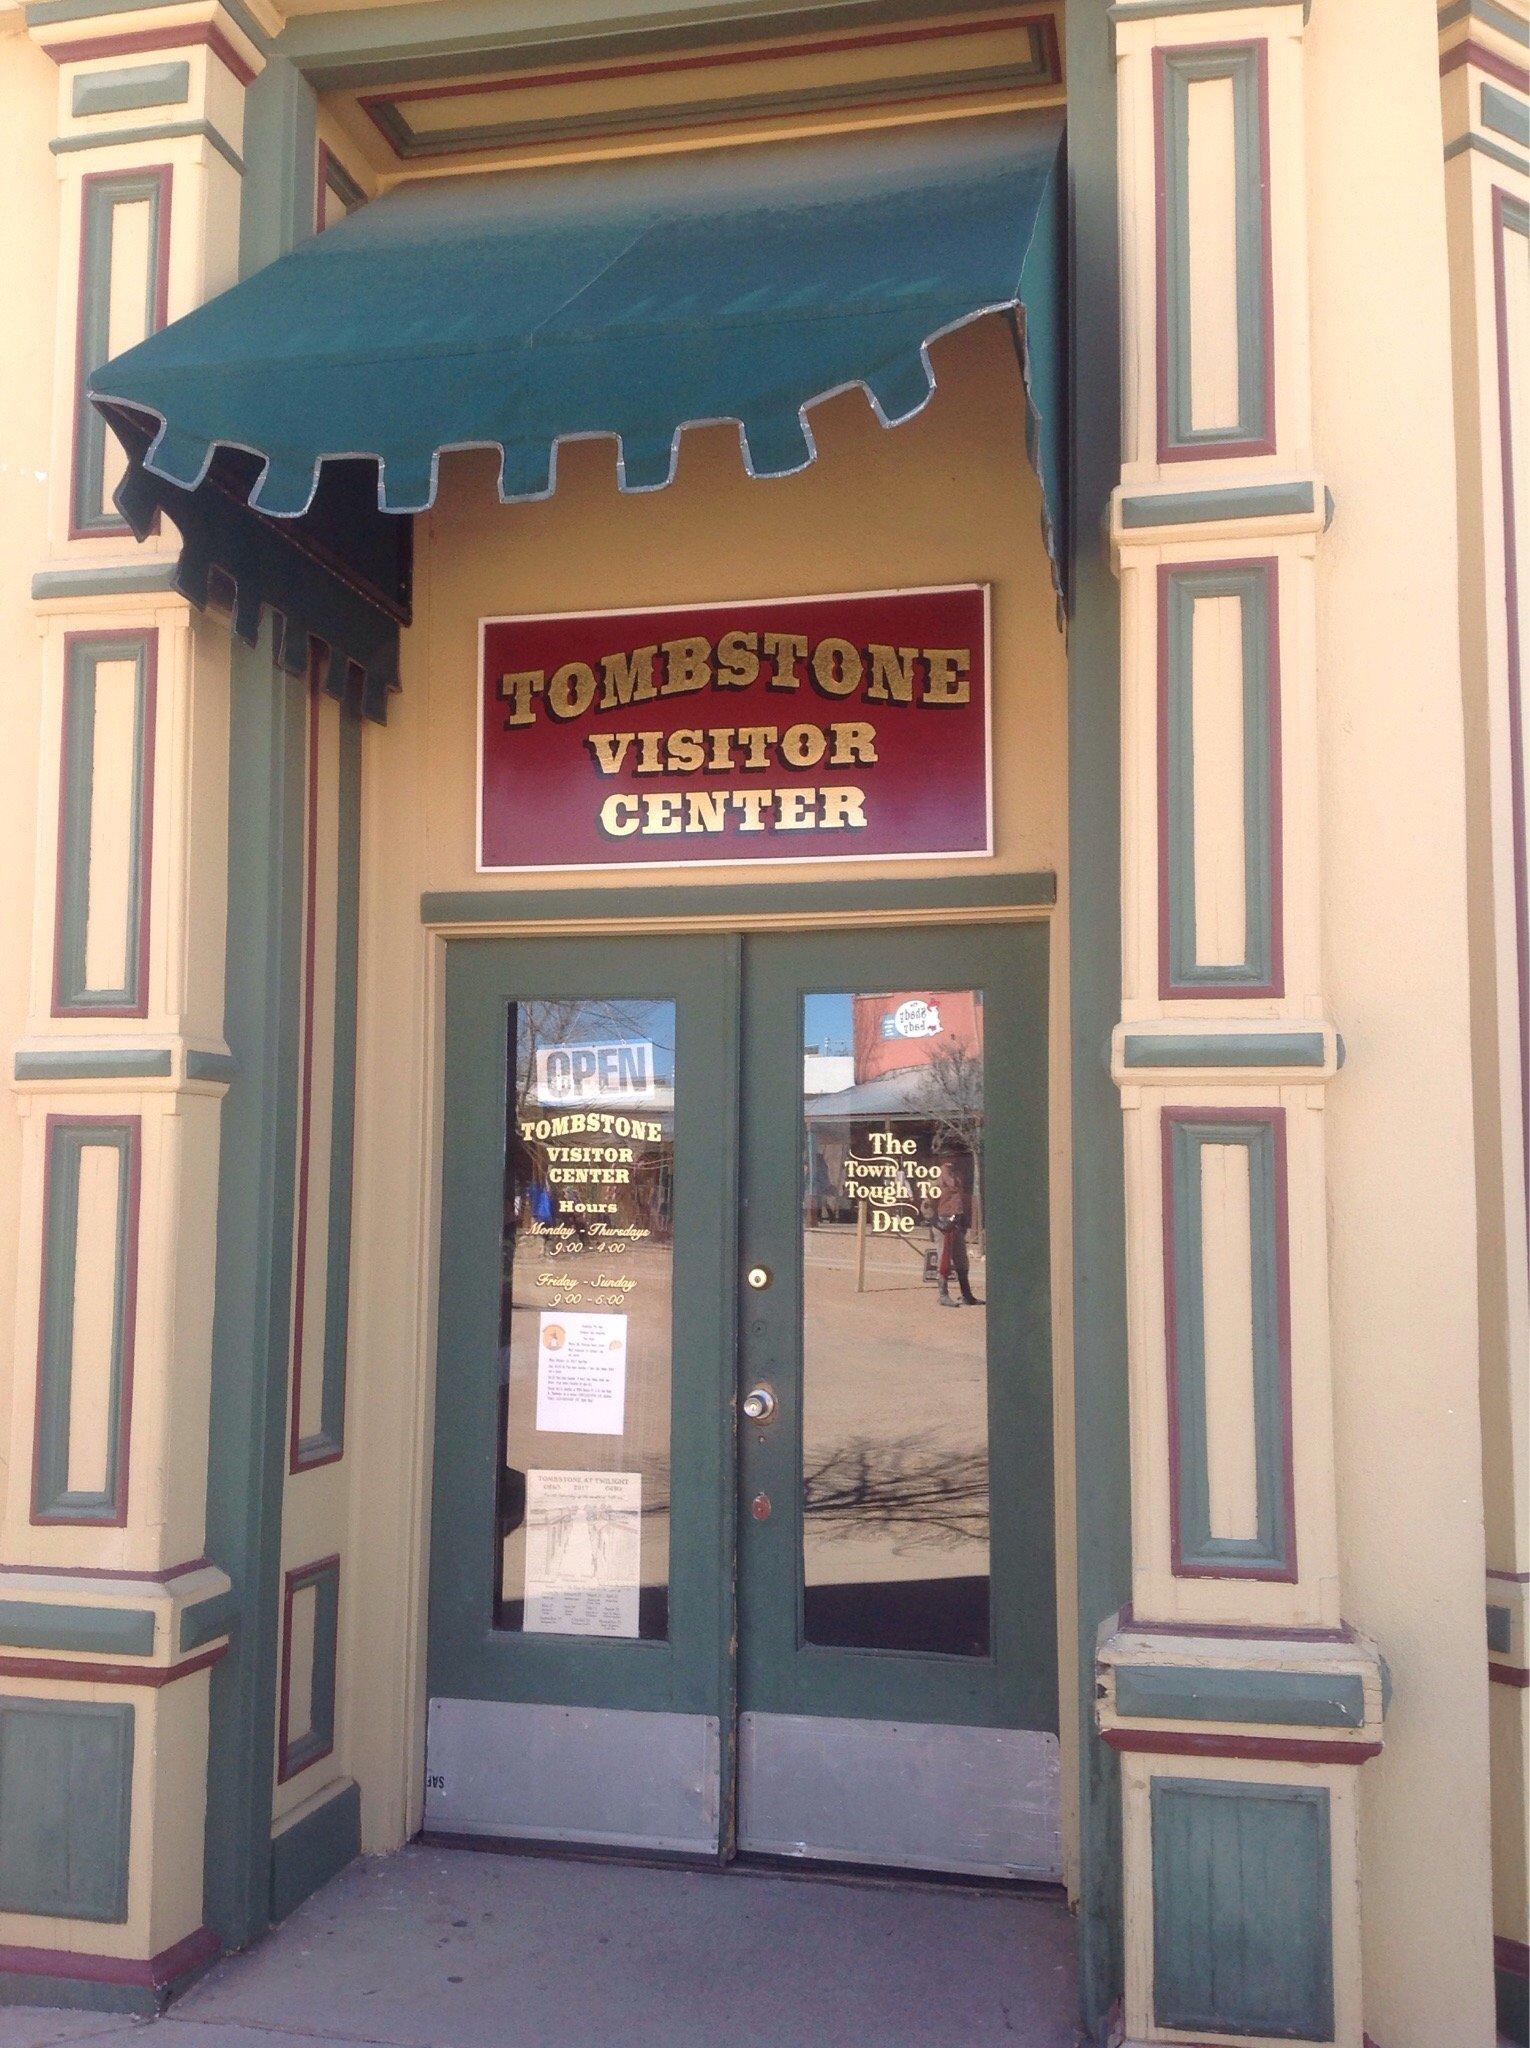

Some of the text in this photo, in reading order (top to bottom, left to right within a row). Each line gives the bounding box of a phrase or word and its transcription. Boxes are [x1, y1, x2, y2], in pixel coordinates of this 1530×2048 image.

[501, 630, 971, 728] TOMBSTONE
[586, 721, 878, 775] VISITOR
[598, 786, 868, 837] CENTER
[546, 1046, 647, 1097] OPEN
[521, 1112, 662, 1142] TOMBSTONE
[546, 1147, 634, 1163] VISITOR
[868, 1133, 917, 1156] The
[549, 1168, 630, 1184] CENTER
[844, 1160, 942, 1179] Town Too
[845, 1181, 942, 1205] Tough To
[558, 1200, 618, 1214] Hours
[525, 1222, 576, 1240] Monday
[587, 1223, 651, 1241] Thursdays
[871, 1210, 915, 1233] Die
[549, 1242, 584, 1256] 9:00
[536, 1273, 579, 1291] Friday
[590, 1274, 638, 1292] Sunday
[538, 1475, 582, 1483] TOMBSTONE
